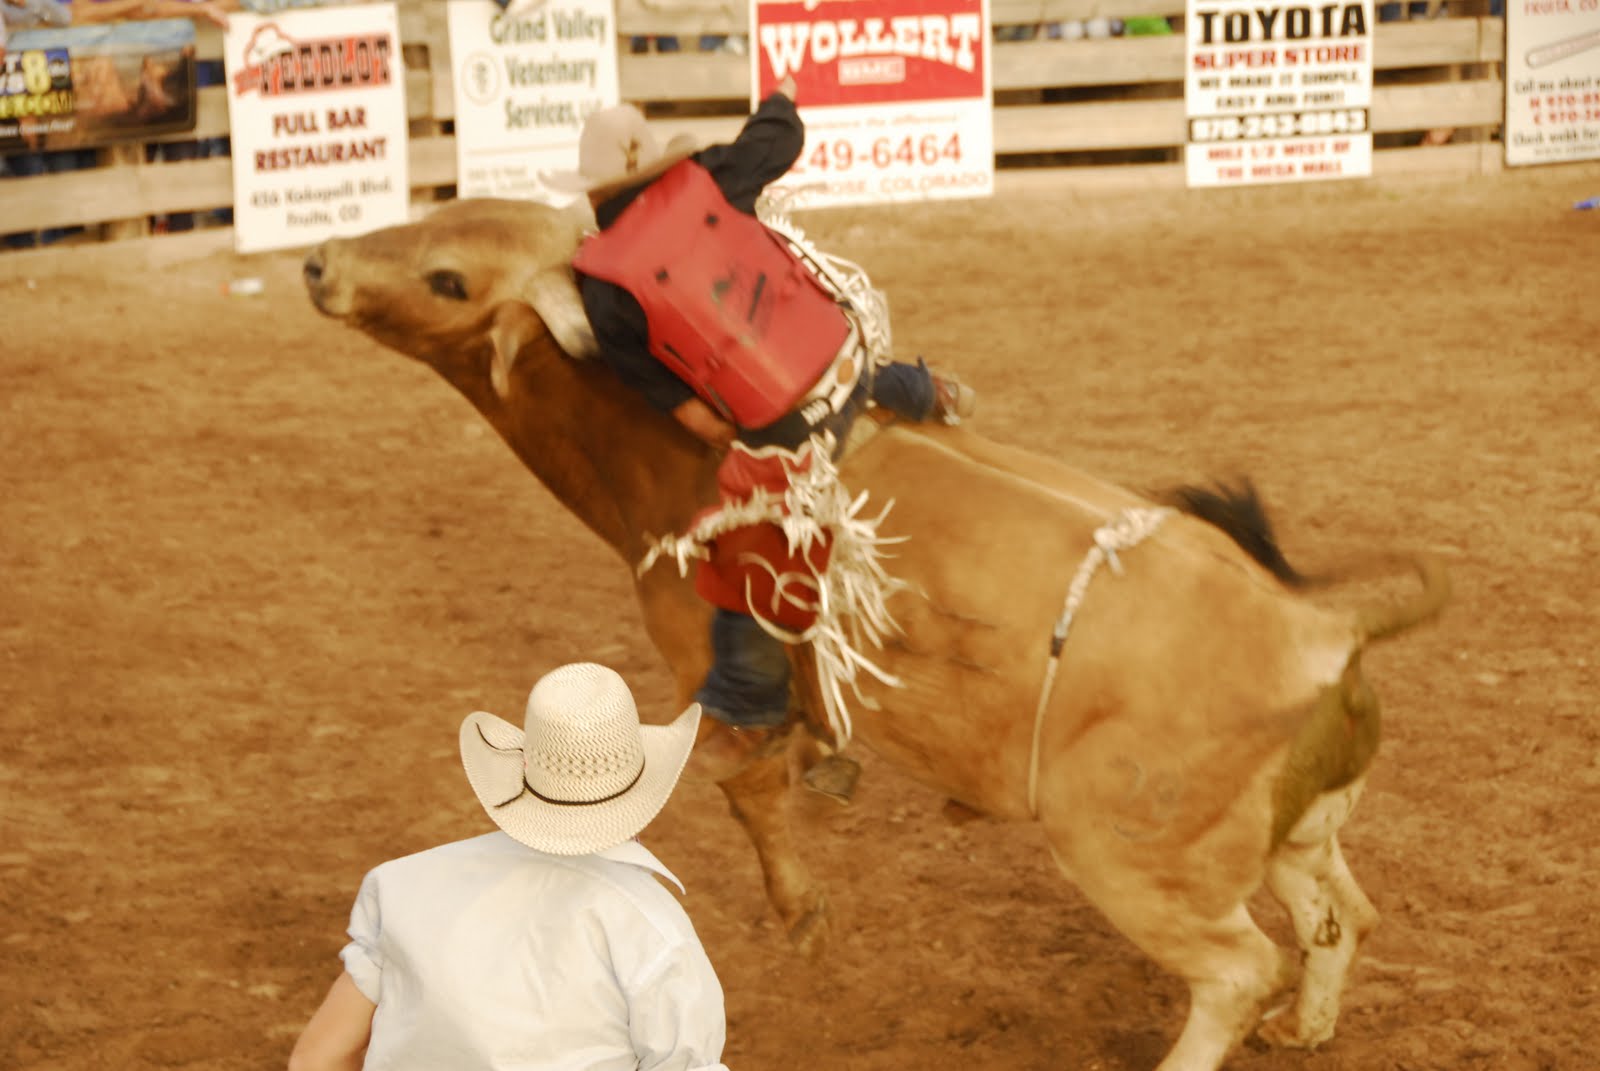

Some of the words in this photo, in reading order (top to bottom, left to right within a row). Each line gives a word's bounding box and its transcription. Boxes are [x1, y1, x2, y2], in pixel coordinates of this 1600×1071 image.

[489, 11, 546, 44] Grand
[553, 9, 607, 45] Valley
[1197, 4, 1366, 44] TOYOTA
[760, 13, 981, 79] WOLLERT
[1194, 50, 1276, 70] SUPER
[1284, 45, 1362, 65] STORE
[505, 54, 597, 89] Veterinary
[273, 113, 319, 136] FULL
[327, 108, 366, 129] BAR
[254, 138, 388, 172] RESTAURANT
[790, 132, 962, 174] 49-6464
